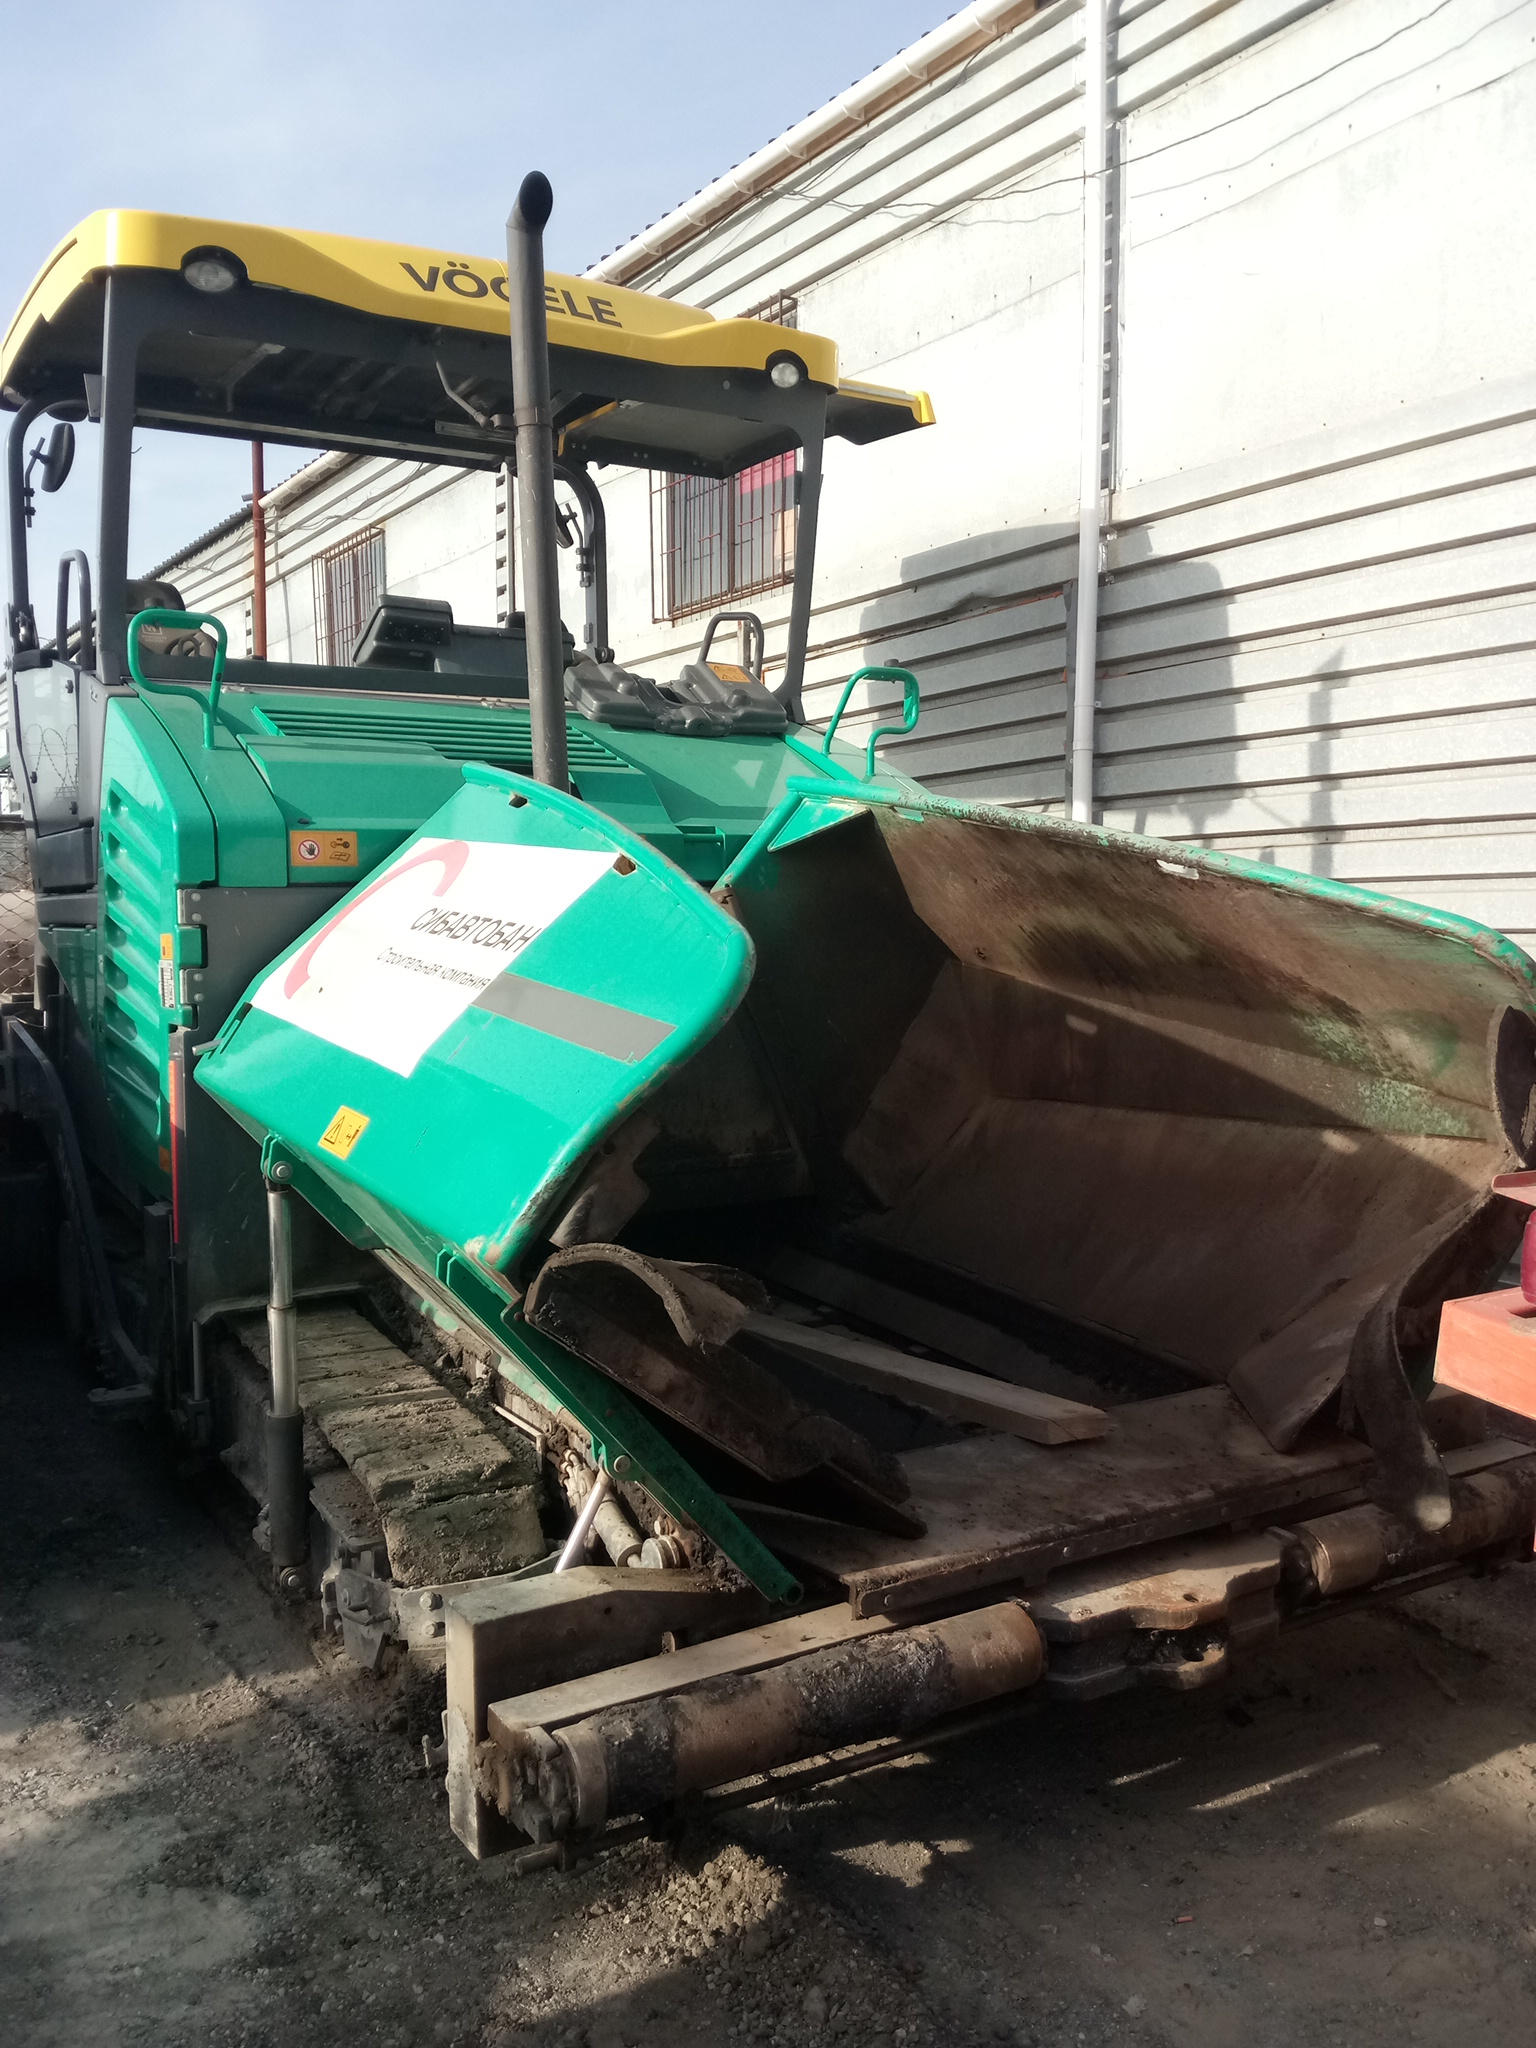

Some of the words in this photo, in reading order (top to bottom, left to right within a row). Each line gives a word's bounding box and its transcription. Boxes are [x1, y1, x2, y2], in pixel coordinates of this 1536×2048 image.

[410, 907, 542, 953] СИБАВТОБАН
[377, 947, 443, 976] Строительная
[438, 966, 491, 990] компания
